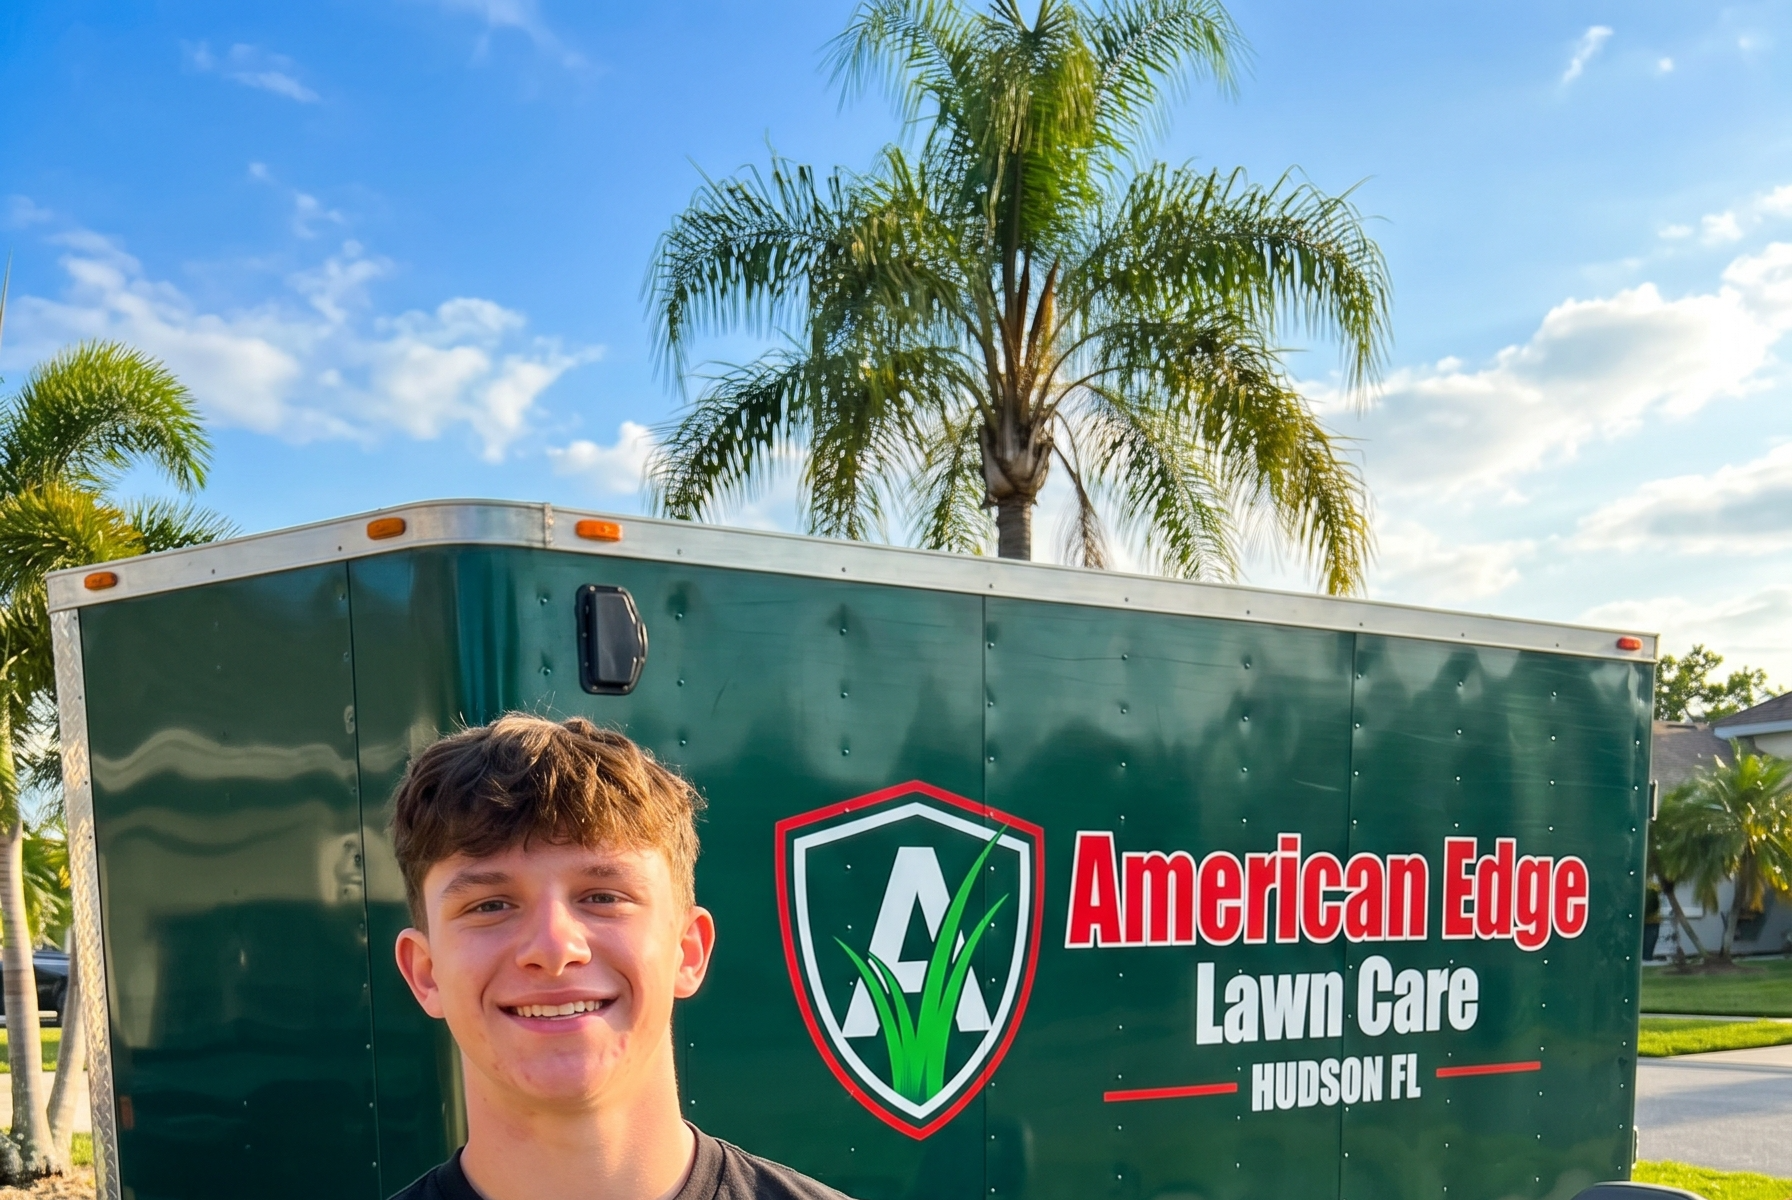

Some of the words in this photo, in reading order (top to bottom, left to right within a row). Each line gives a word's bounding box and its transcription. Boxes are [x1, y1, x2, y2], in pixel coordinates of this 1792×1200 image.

[841, 846, 992, 1038] A
[1065, 831, 1428, 949] American
[1442, 836, 1589, 951] Edge
[1196, 962, 1344, 1045] Lawn
[1357, 955, 1479, 1036] Care
[1252, 1055, 1383, 1112] HUDSON
[1390, 1053, 1421, 1100] FL
